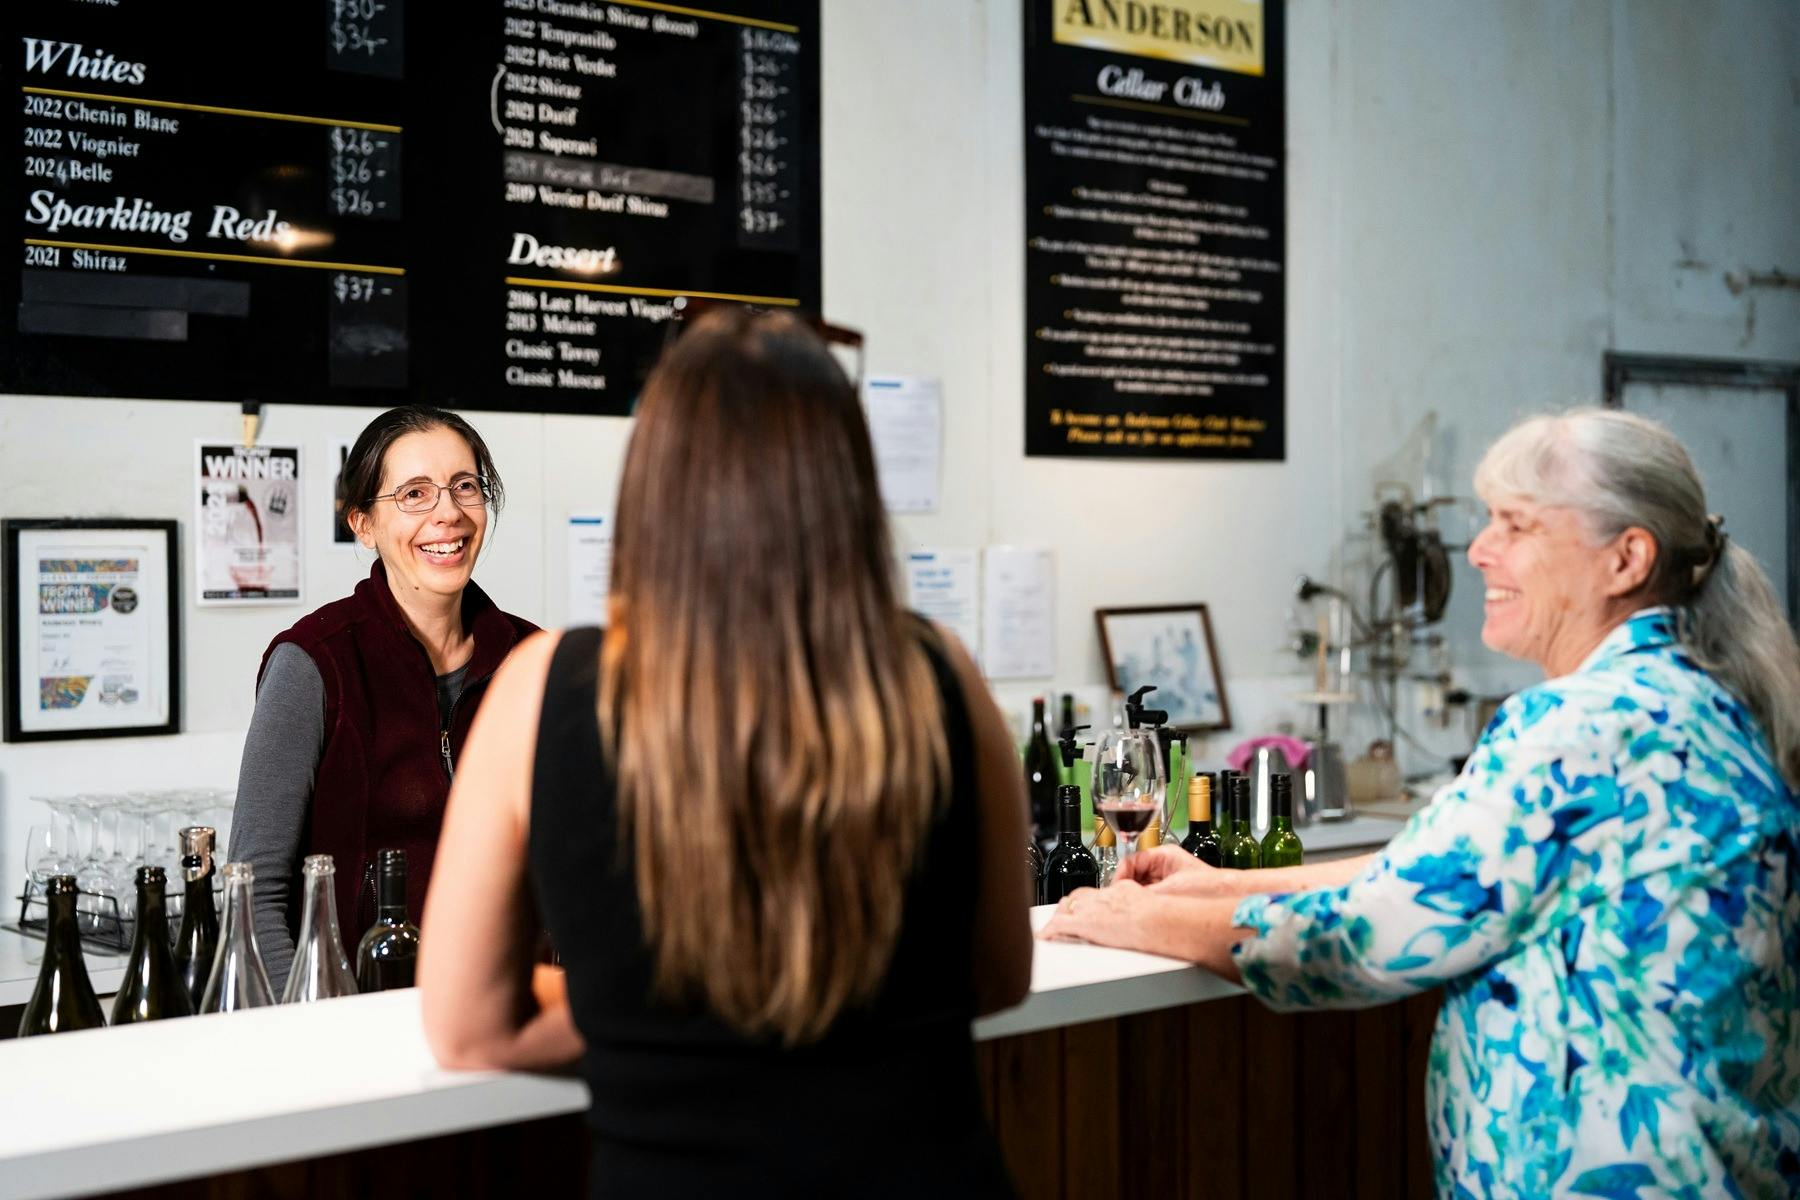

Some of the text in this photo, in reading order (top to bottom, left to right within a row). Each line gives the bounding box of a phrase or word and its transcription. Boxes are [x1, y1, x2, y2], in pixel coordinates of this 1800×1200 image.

[607, 5, 650, 30] Shiraz
[1064, 0, 1256, 53] ANDERSON
[23, 37, 146, 85] Whites
[538, 76, 582, 100] Shiraz
[1097, 64, 1225, 111] Cellar Club
[24, 95, 180, 134] 2022 Chenin Blanc
[538, 102, 579, 126] Durif
[24, 127, 140, 159] 2022 Viognier
[24, 156, 112, 186] 2024 Belle
[25, 189, 293, 243] Sparkling Reds
[587, 190, 626, 213] Durif
[626, 194, 670, 218] Shiraz
[25, 246, 127, 272] 2021 Shiraz
[508, 232, 617, 273] Dessert
[540, 291, 572, 313] Late
[505, 338, 601, 367] Classic Tawny
[505, 365, 555, 387] Classic
[205, 455, 296, 480] WINNER
[42, 598, 95, 613] WINNER
